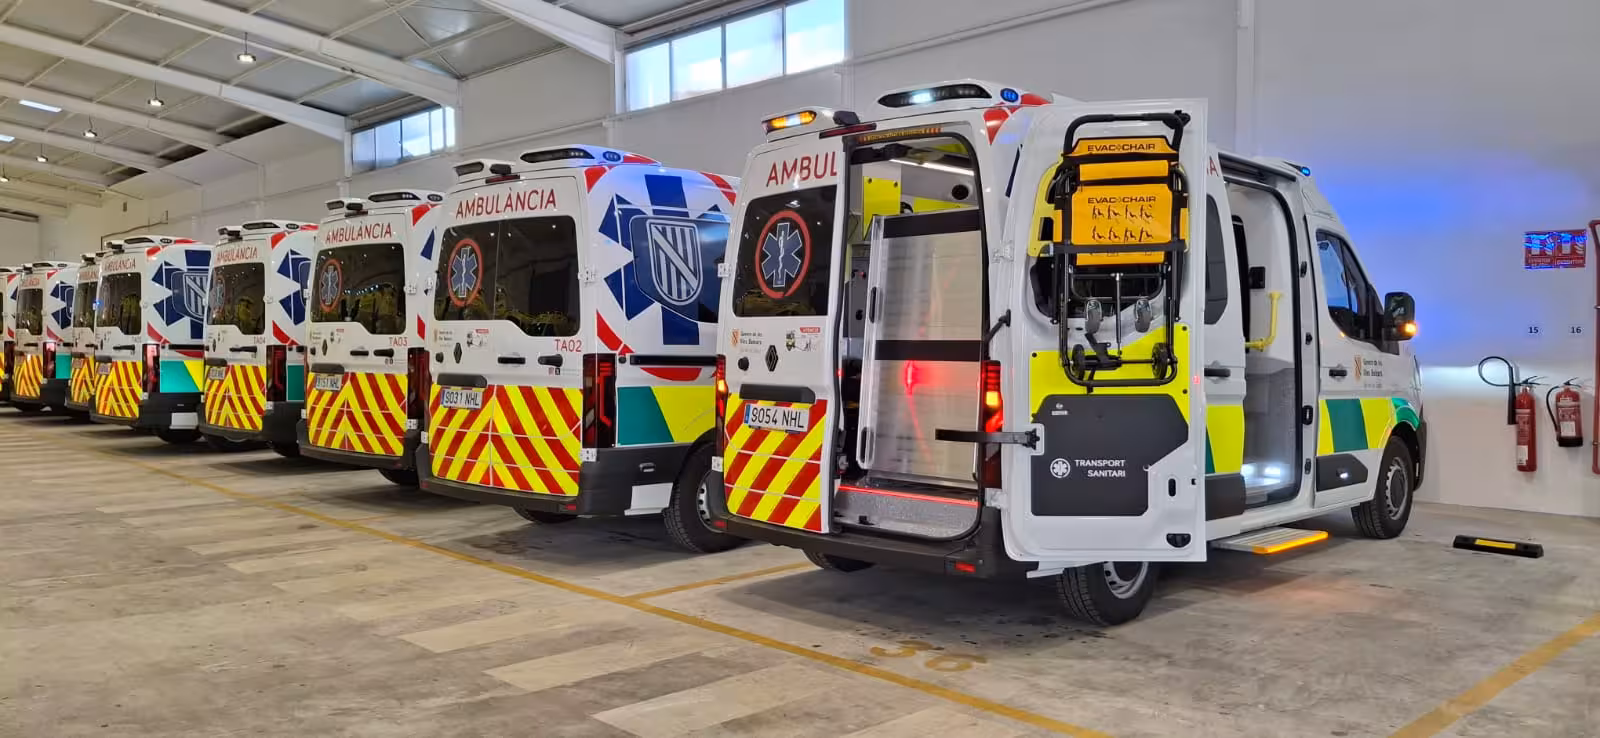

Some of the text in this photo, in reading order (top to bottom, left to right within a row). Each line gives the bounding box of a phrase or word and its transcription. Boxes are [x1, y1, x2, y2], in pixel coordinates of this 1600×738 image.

[1121, 143, 1156, 151] CHAIR
[456, 187, 556, 219] AMBULÀNCIA
[325, 221, 392, 244] AMBULÀNCIA
[1529, 326, 1539, 334] 15
[1570, 326, 1582, 334] 16
[388, 337, 408, 347] TA03
[555, 339, 582, 352] TA02
[445, 391, 480, 406] 9031 NHL
[751, 407, 804, 428] 9054 NHL
[1074, 459, 1126, 468] TRANSPORT
[1087, 469, 1126, 478] SANITARI
[869, 640, 988, 673] 36
